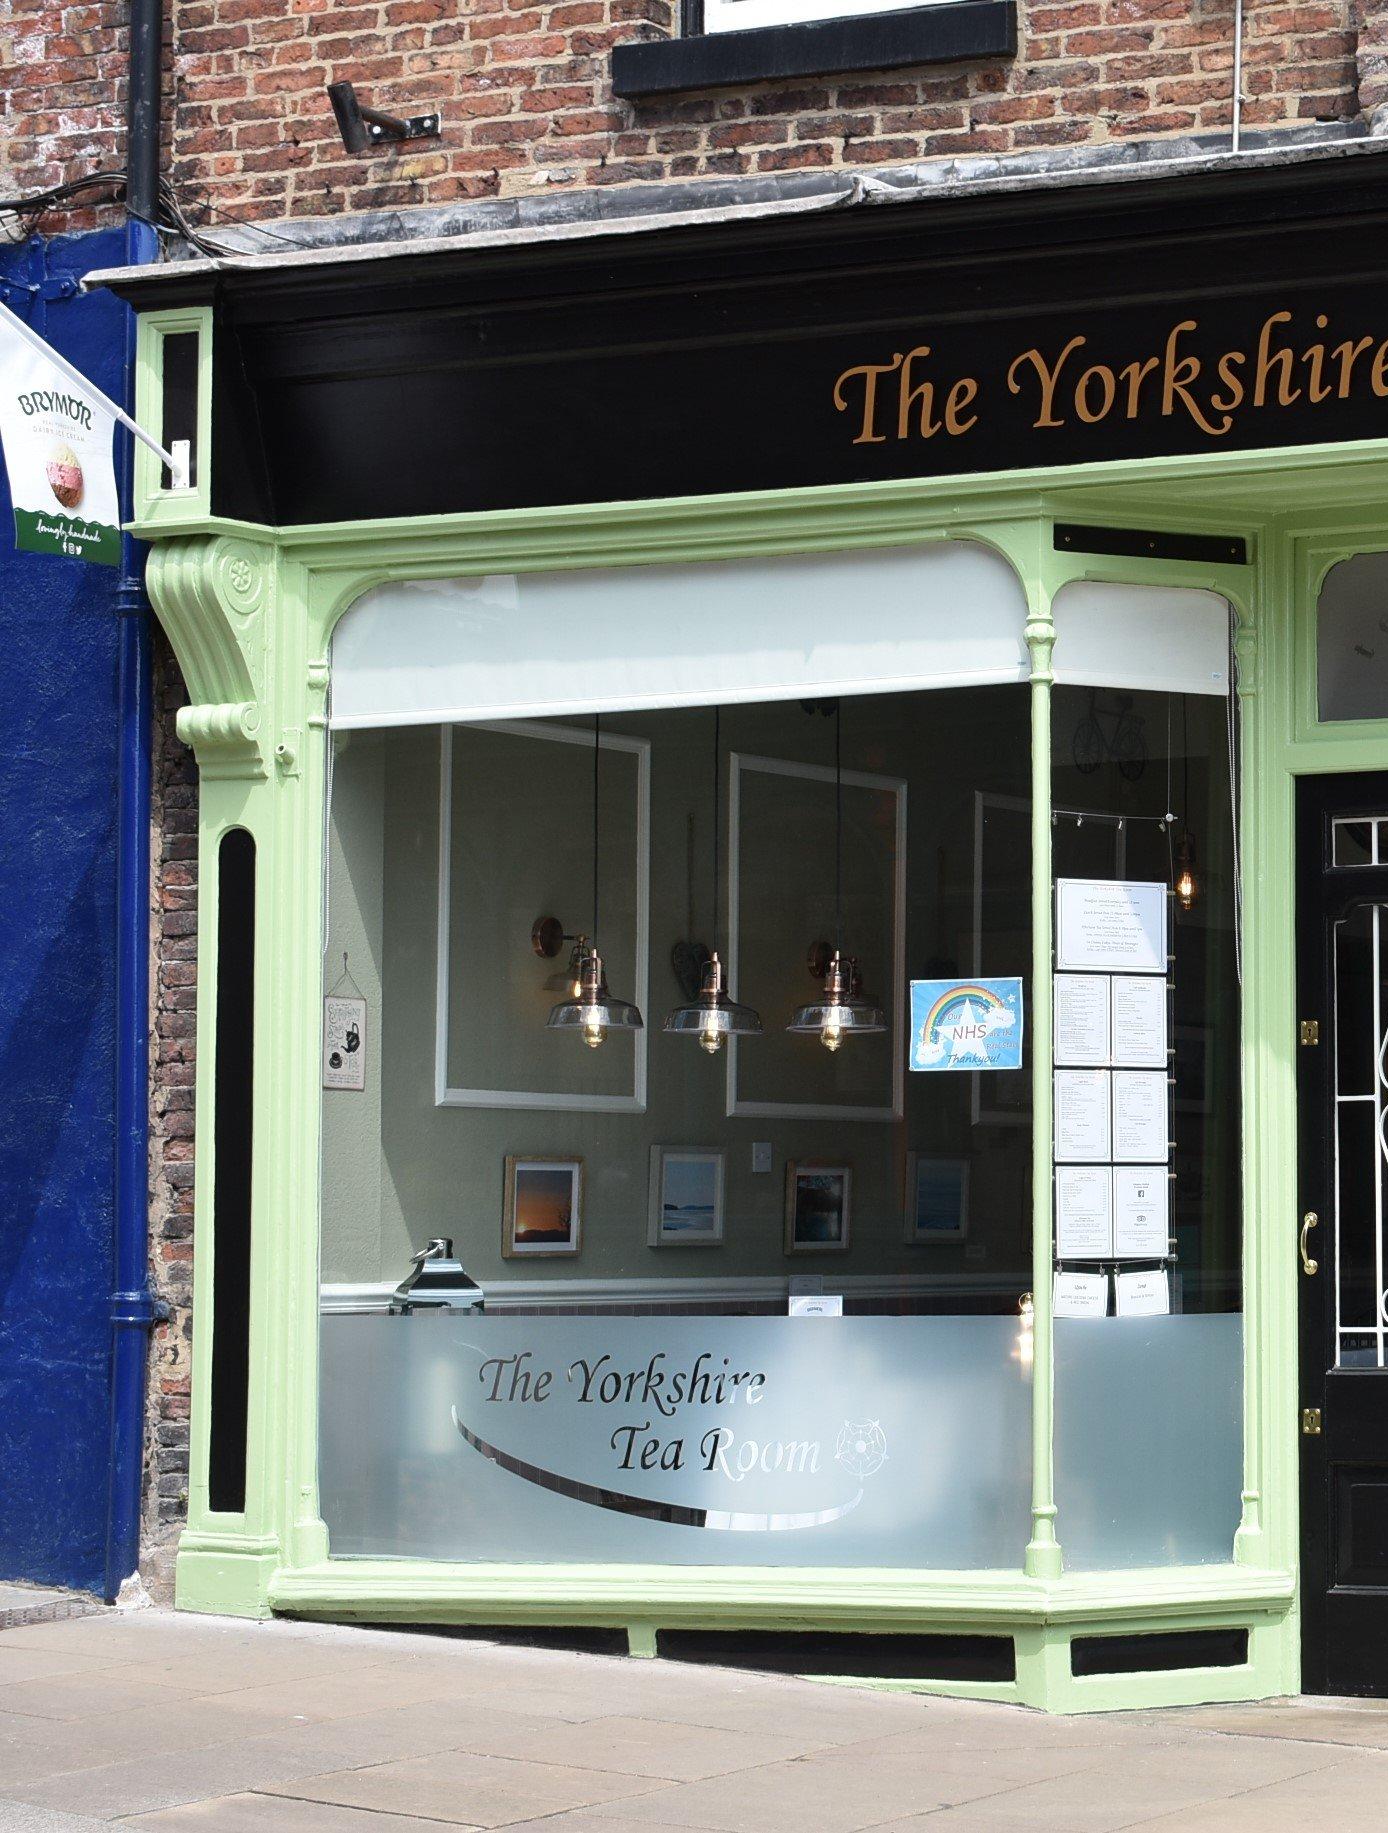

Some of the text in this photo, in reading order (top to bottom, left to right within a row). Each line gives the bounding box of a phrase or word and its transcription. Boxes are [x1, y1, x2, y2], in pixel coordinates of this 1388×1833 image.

[18, 391, 92, 431] BRYMOR
[833, 346, 978, 443] The
[952, 1024, 988, 1040] NHS
[947, 1053, 1001, 1066] Thankyou!
[479, 1351, 766, 1417] The Yorkshire
[610, 1421, 822, 1482] Tea Room
